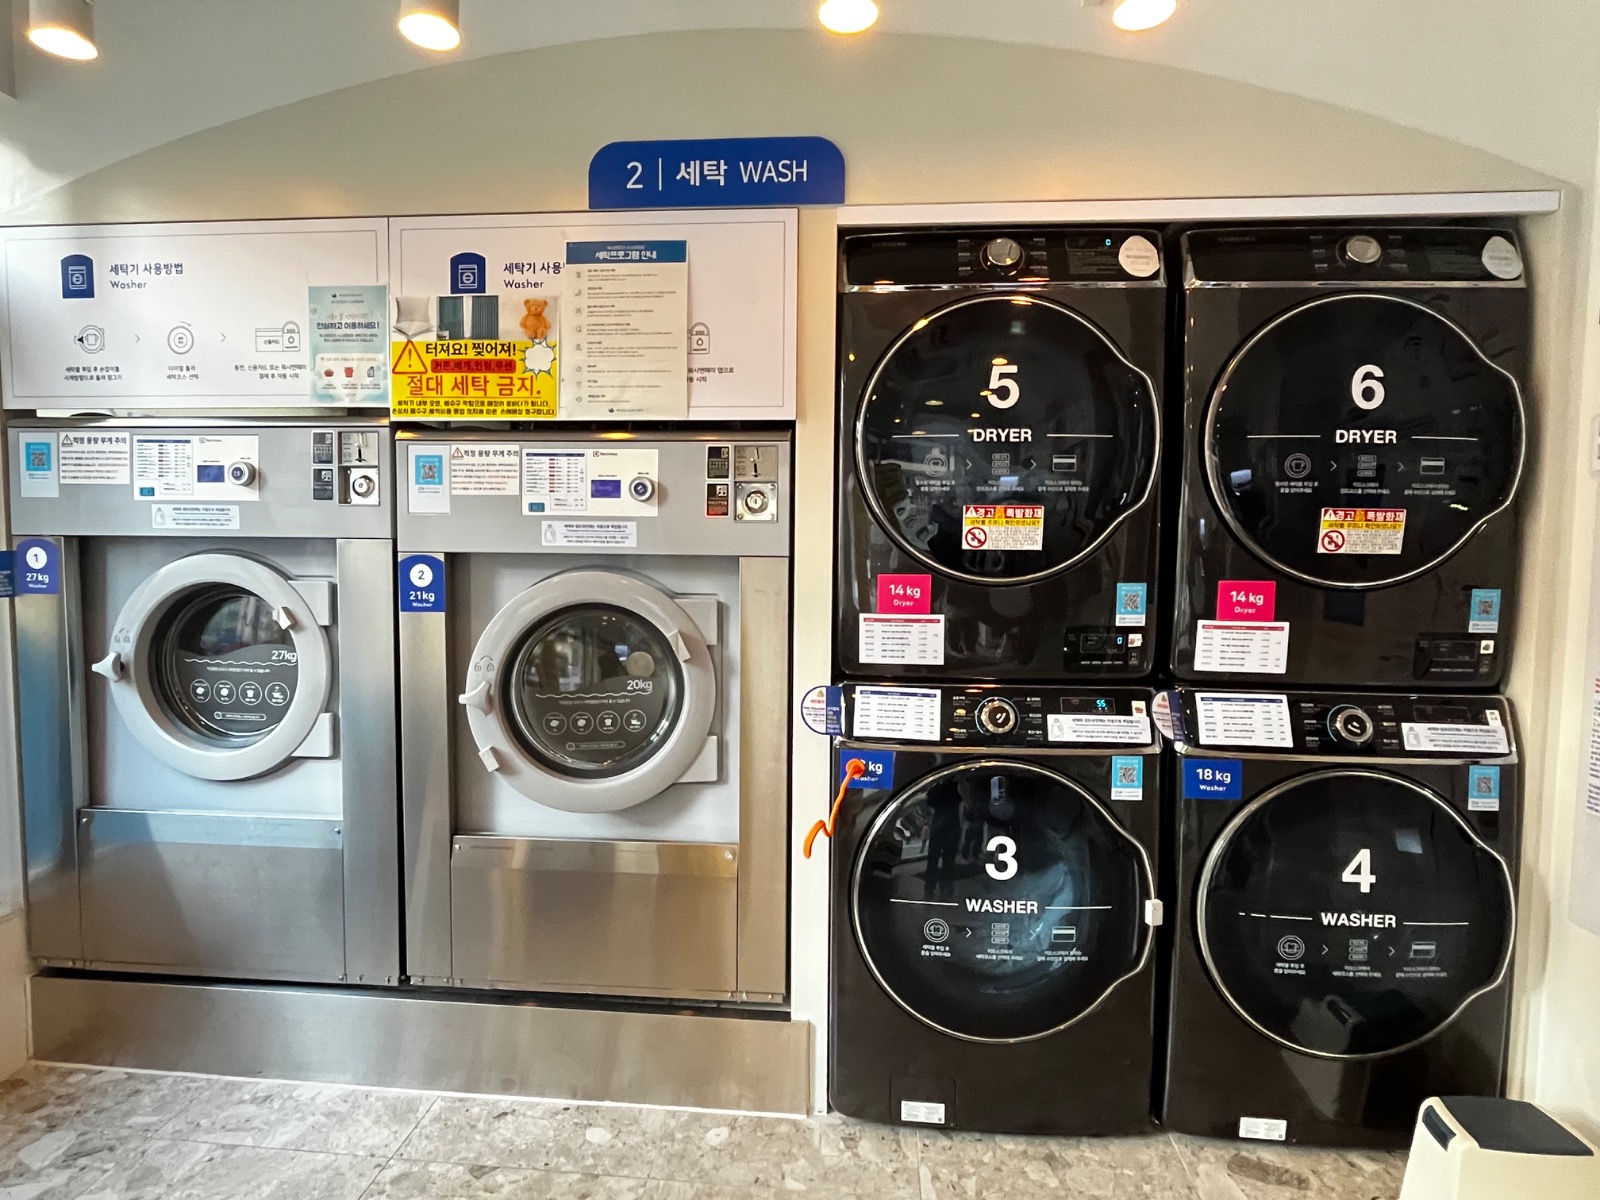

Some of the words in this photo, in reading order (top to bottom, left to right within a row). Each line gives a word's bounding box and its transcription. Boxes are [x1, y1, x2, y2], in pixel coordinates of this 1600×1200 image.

[626, 161, 643, 188] 2
[676, 160, 728, 186] 세탁
[740, 160, 808, 183] WASH
[641, 250, 657, 260] 안내
[110, 263, 139, 276] 세탁기
[143, 262, 184, 276] 사용방법
[504, 262, 536, 274] 세탁기
[540, 262, 565, 274] 사용
[110, 280, 147, 289] Washer
[504, 279, 544, 288] Washer
[426, 342, 468, 357] 터져요!
[472, 342, 516, 357] 찢어져!
[406, 375, 443, 396] 절대
[451, 375, 490, 396] 세탁
[496, 375, 541, 396] 금지.
[988, 364, 1020, 408] 5
[1352, 364, 1385, 410] 6
[972, 428, 1032, 442] DRYER
[1335, 430, 1397, 444] DRYER
[976, 508, 994, 518] 경고
[1006, 508, 1042, 518] 폭발화재
[1335, 510, 1354, 520] 경고
[1366, 511, 1404, 522] 폭발화재
[34, 554, 38, 562] 1
[418, 570, 425, 580] 2
[889, 584, 904, 596] 14
[906, 586, 920, 599] kg
[1230, 591, 1246, 602] 14
[1249, 592, 1264, 606] kg
[894, 599, 914, 607] Dryer
[1234, 606, 1256, 614] Dryer
[1117, 637, 1123, 645] 0
[271, 650, 297, 663] 27kg
[627, 679, 653, 691] 20kg
[868, 761, 883, 774] kg
[1196, 768, 1213, 780] 18
[1216, 770, 1230, 784] kg
[984, 835, 1018, 881] 3
[1342, 848, 1376, 893] 4
[965, 899, 1038, 914] WASHER
[1320, 912, 1396, 928] WASHER
